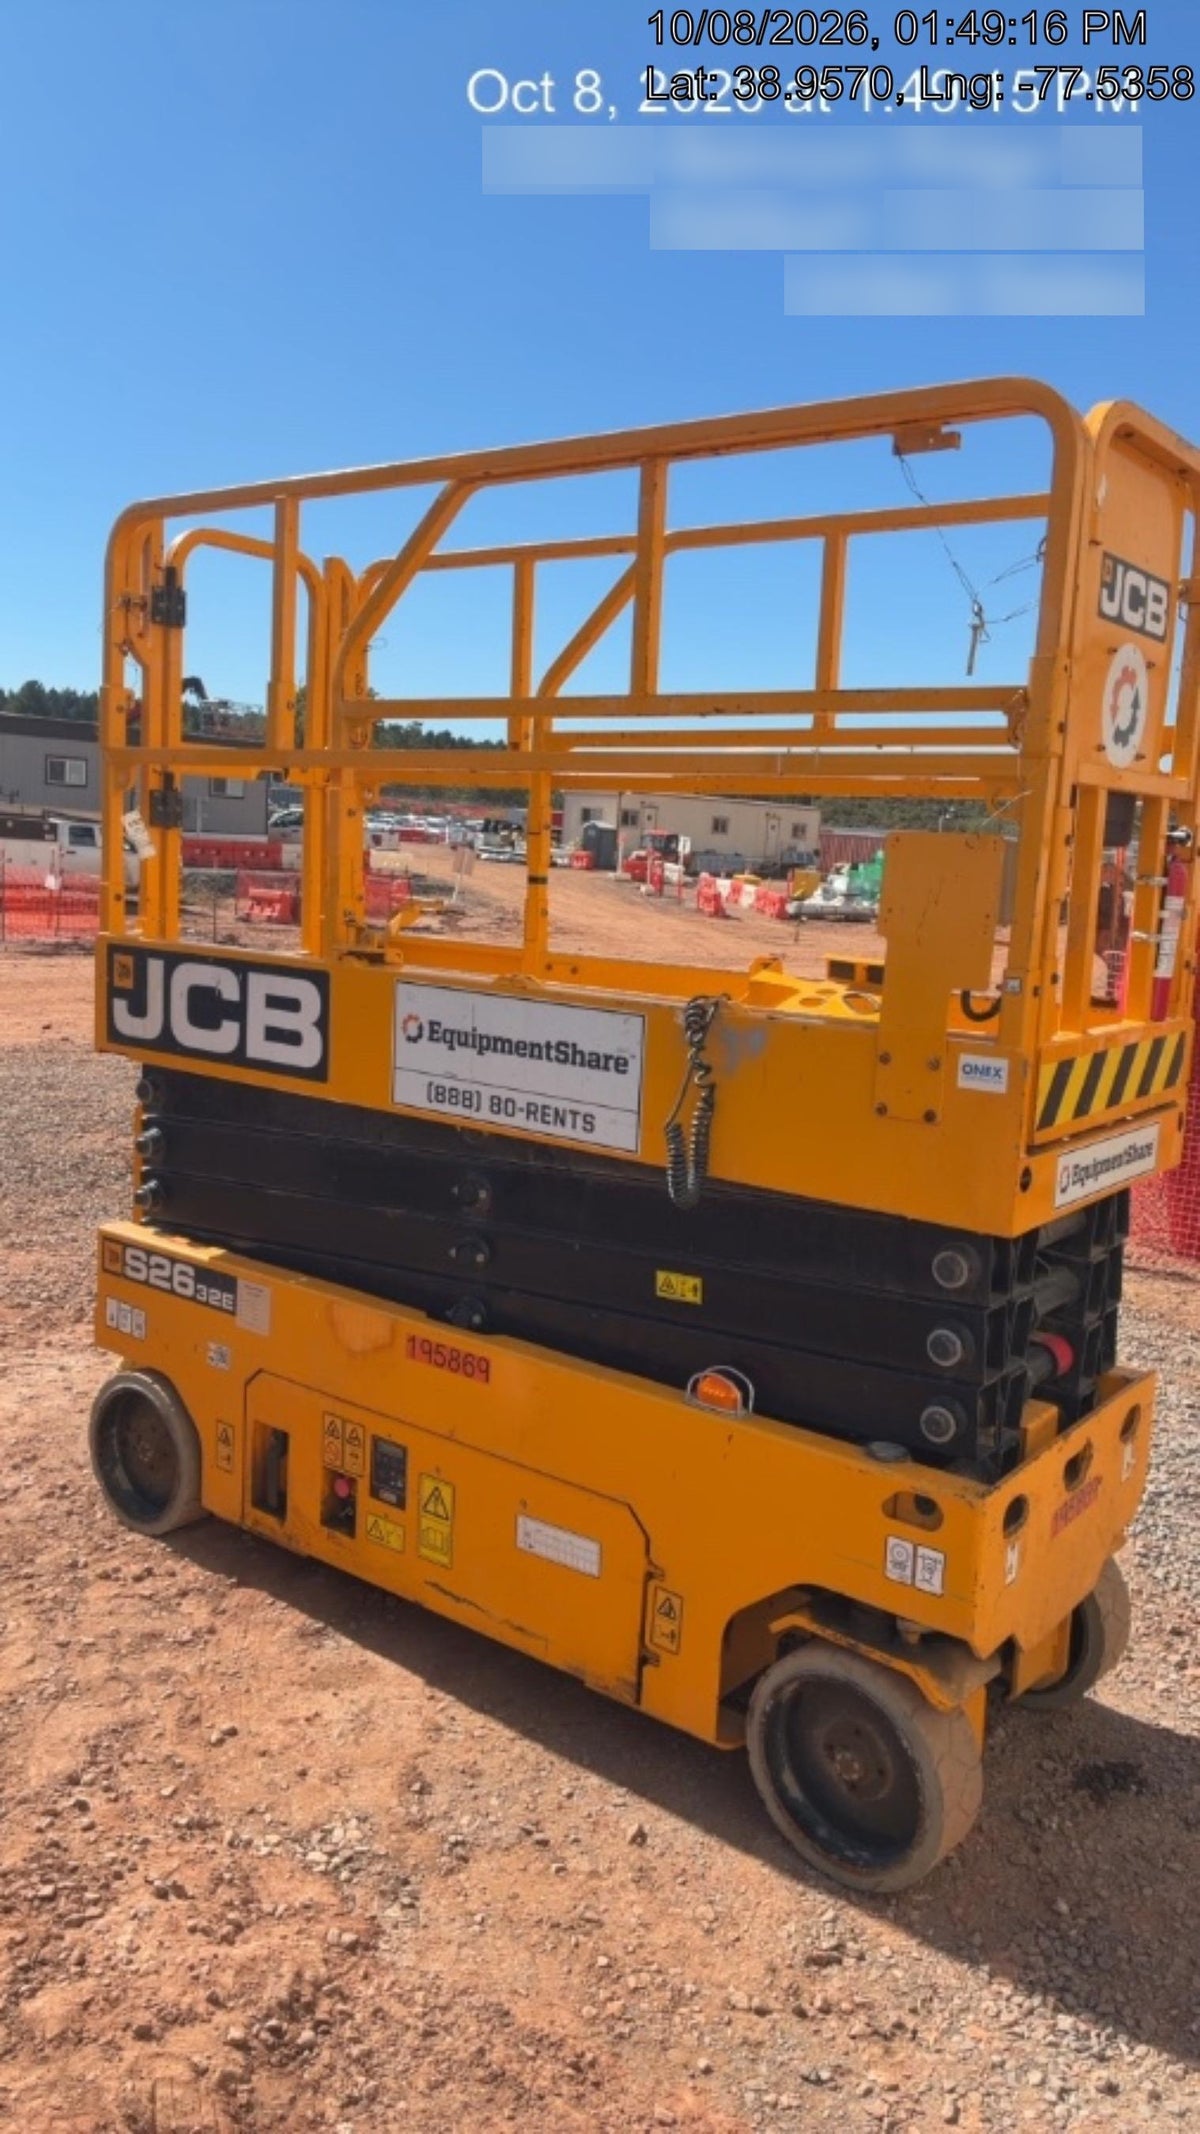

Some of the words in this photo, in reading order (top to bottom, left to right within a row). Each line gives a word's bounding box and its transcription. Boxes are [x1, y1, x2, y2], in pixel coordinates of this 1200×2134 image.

[1101, 564, 1168, 637] JCB
[112, 957, 324, 1069] JCB
[427, 1018, 630, 1075] EquipmentShare
[426, 1080, 482, 1113] (888)
[488, 1095, 597, 1135] 80-RENTS
[407, 1334, 490, 1384] 195869
